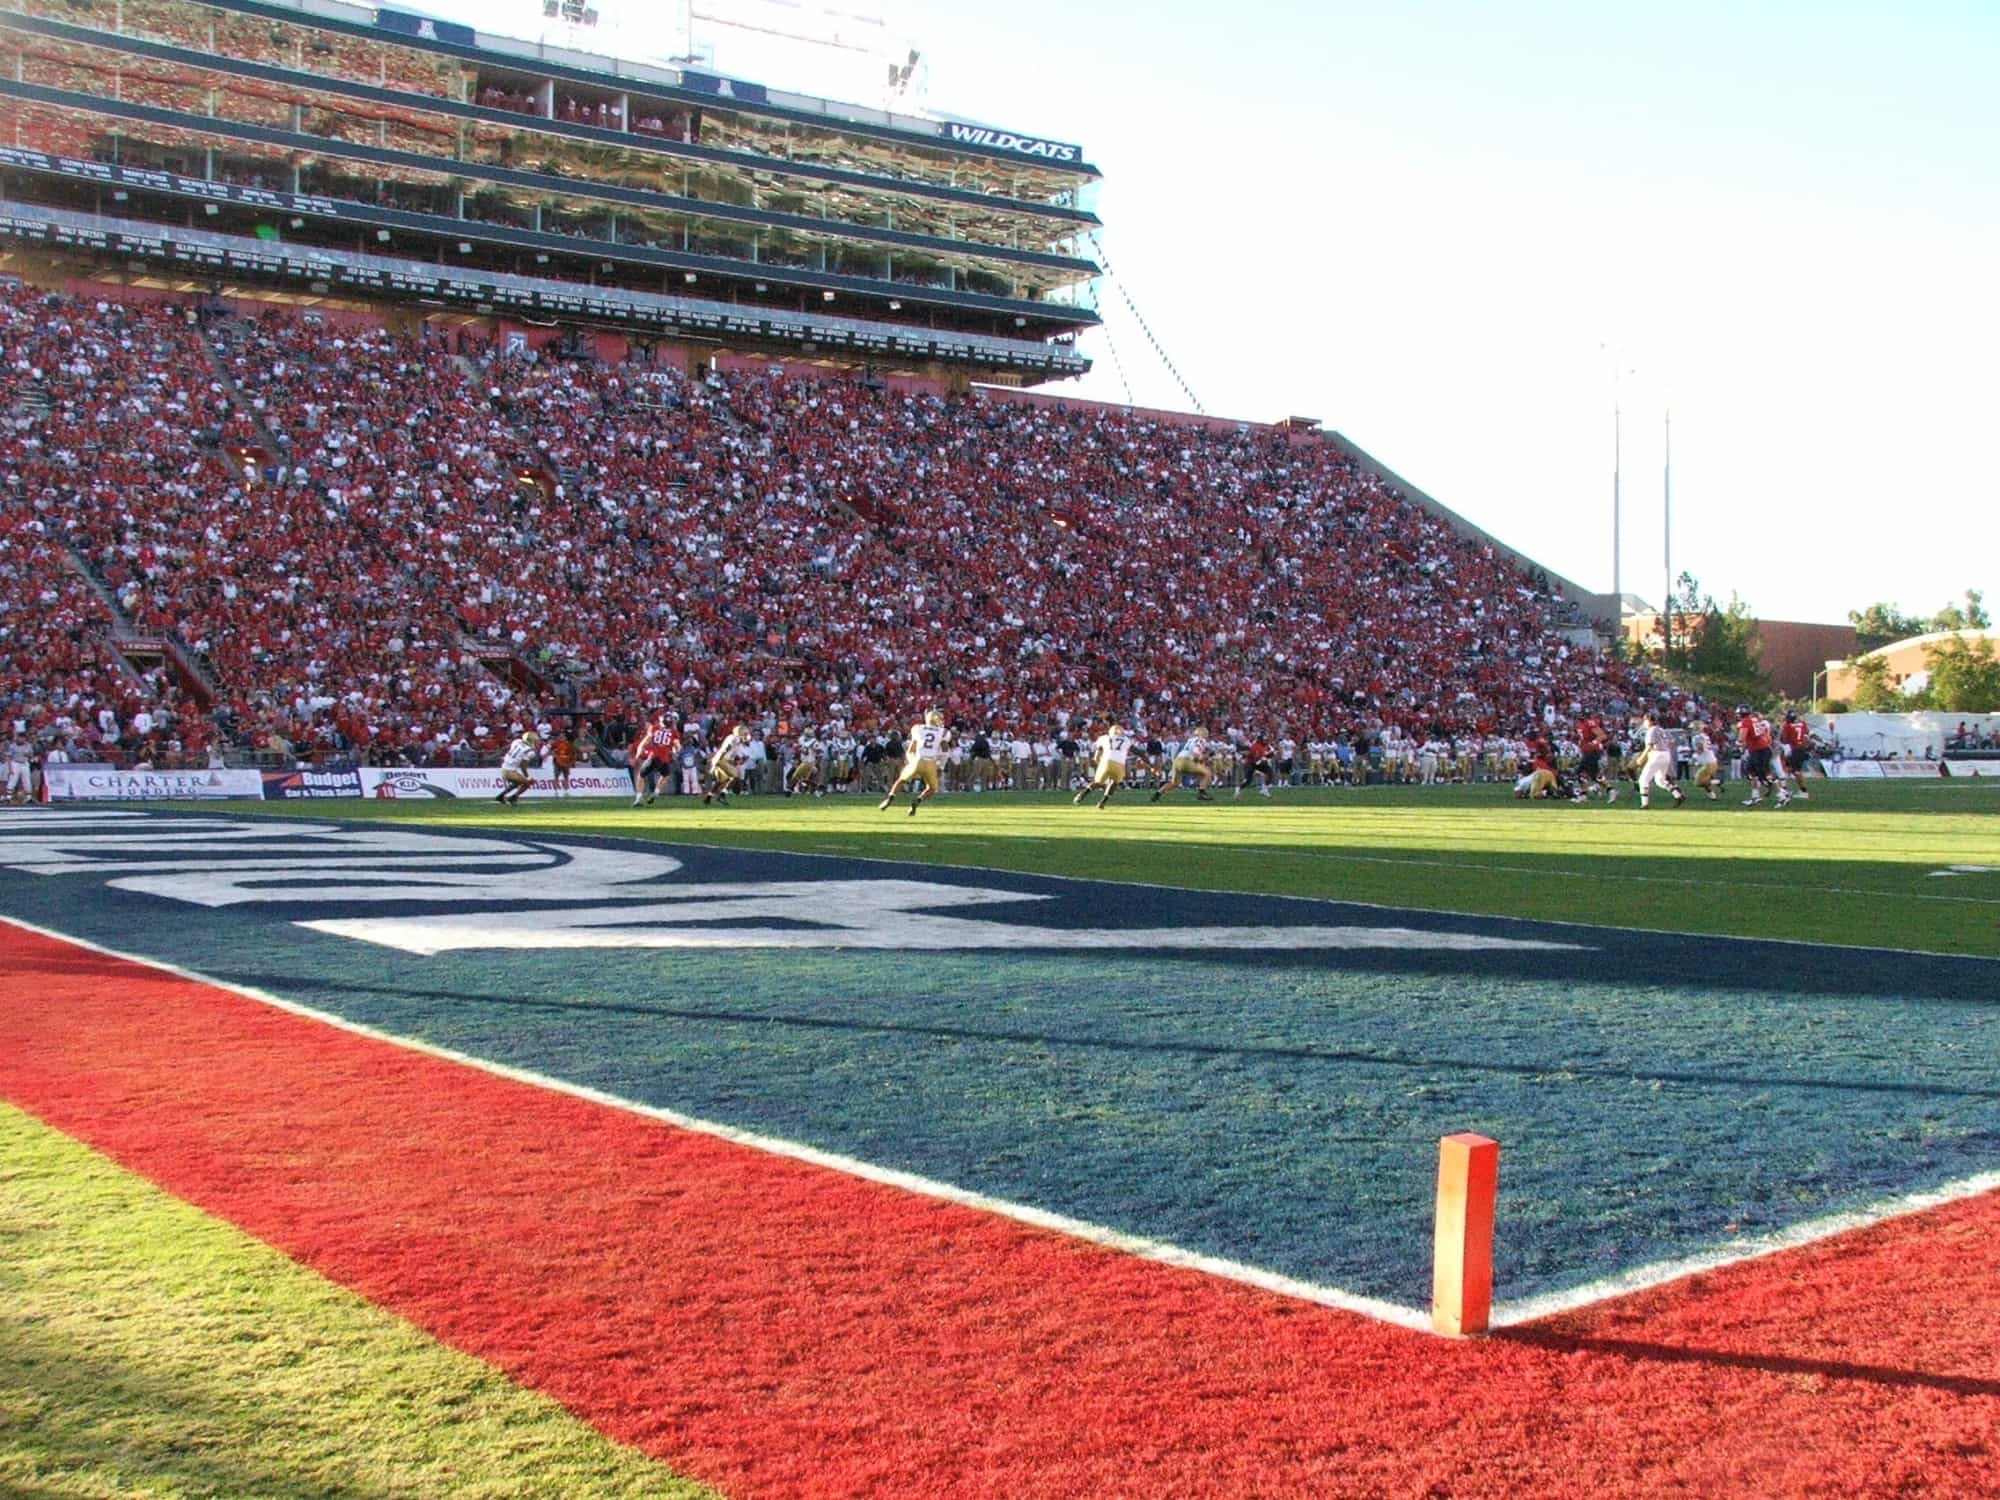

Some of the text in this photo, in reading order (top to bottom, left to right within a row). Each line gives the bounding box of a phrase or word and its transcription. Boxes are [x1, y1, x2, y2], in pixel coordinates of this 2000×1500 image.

[950, 124, 1076, 161] WILDCATS
[653, 729, 672, 746] 86
[923, 732, 935, 749] 2
[1108, 737, 1125, 751] 17
[88, 775, 204, 788] CHARTER
[302, 772, 358, 787] Budget
[385, 771, 428, 780] Desert
[117, 787, 196, 796] FUNDING
